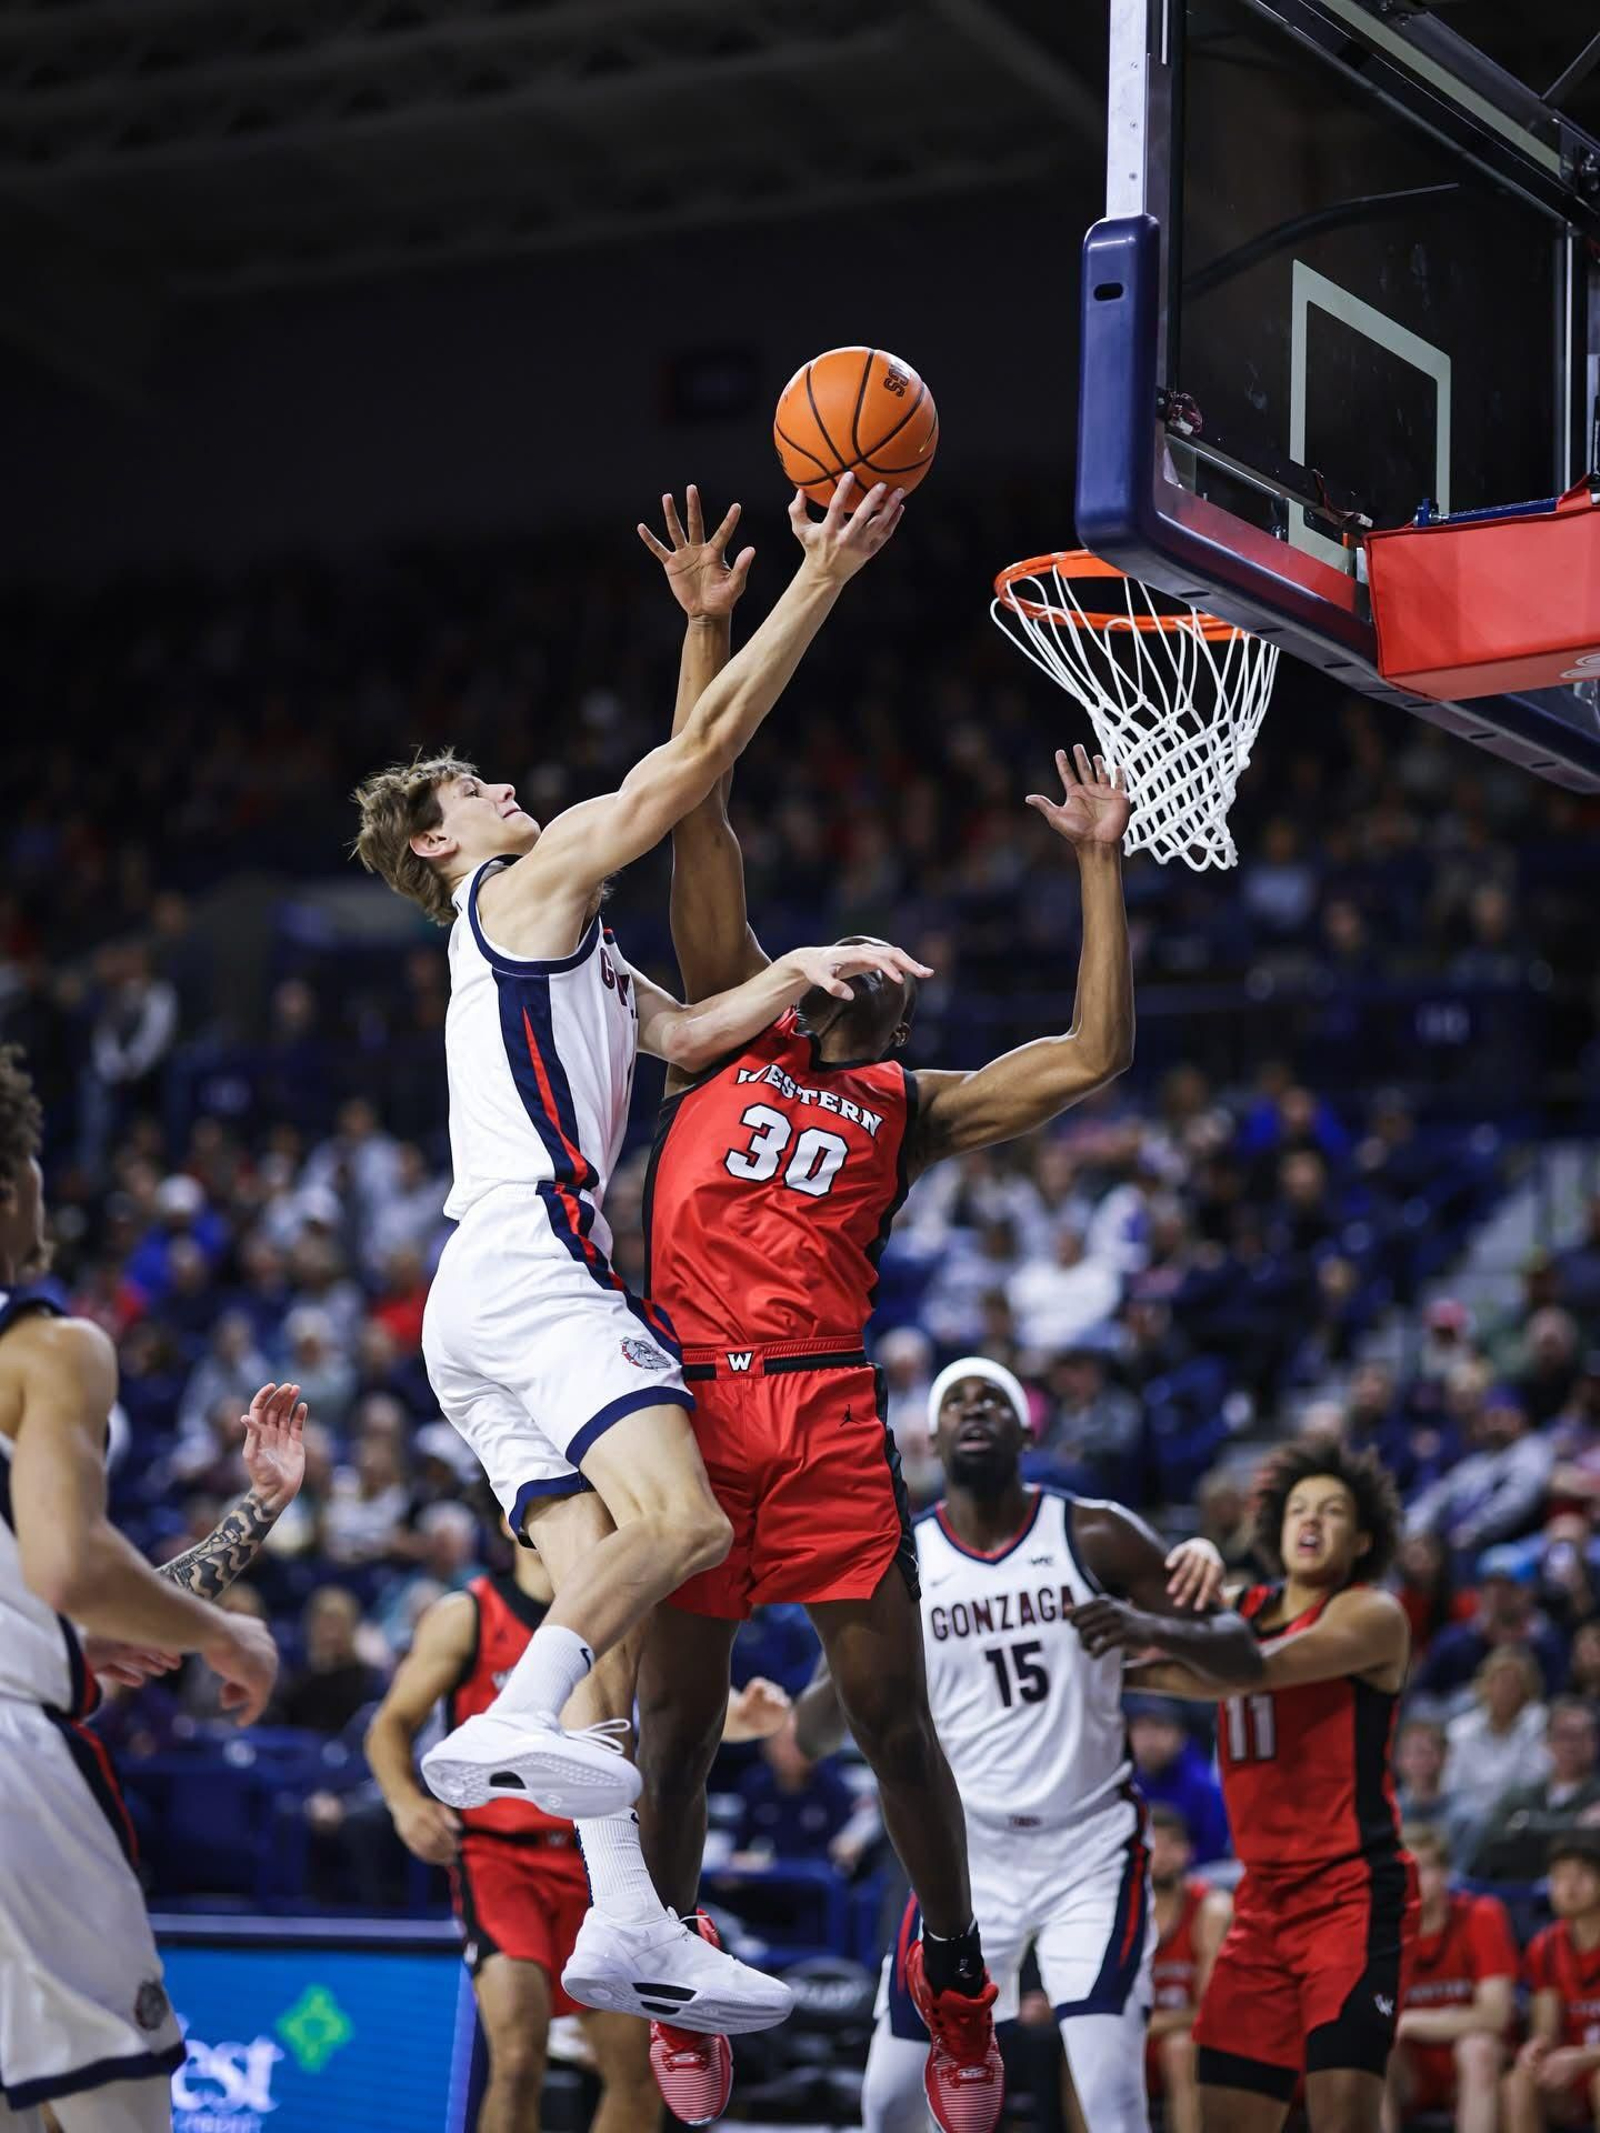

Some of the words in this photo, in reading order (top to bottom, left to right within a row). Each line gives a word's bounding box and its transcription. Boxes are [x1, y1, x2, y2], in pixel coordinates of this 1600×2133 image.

[724, 1102, 849, 1197] 30
[930, 1585, 1079, 1642] GONZAGA
[984, 1640, 1050, 1708] 15
[1226, 1694, 1276, 1761] 11
